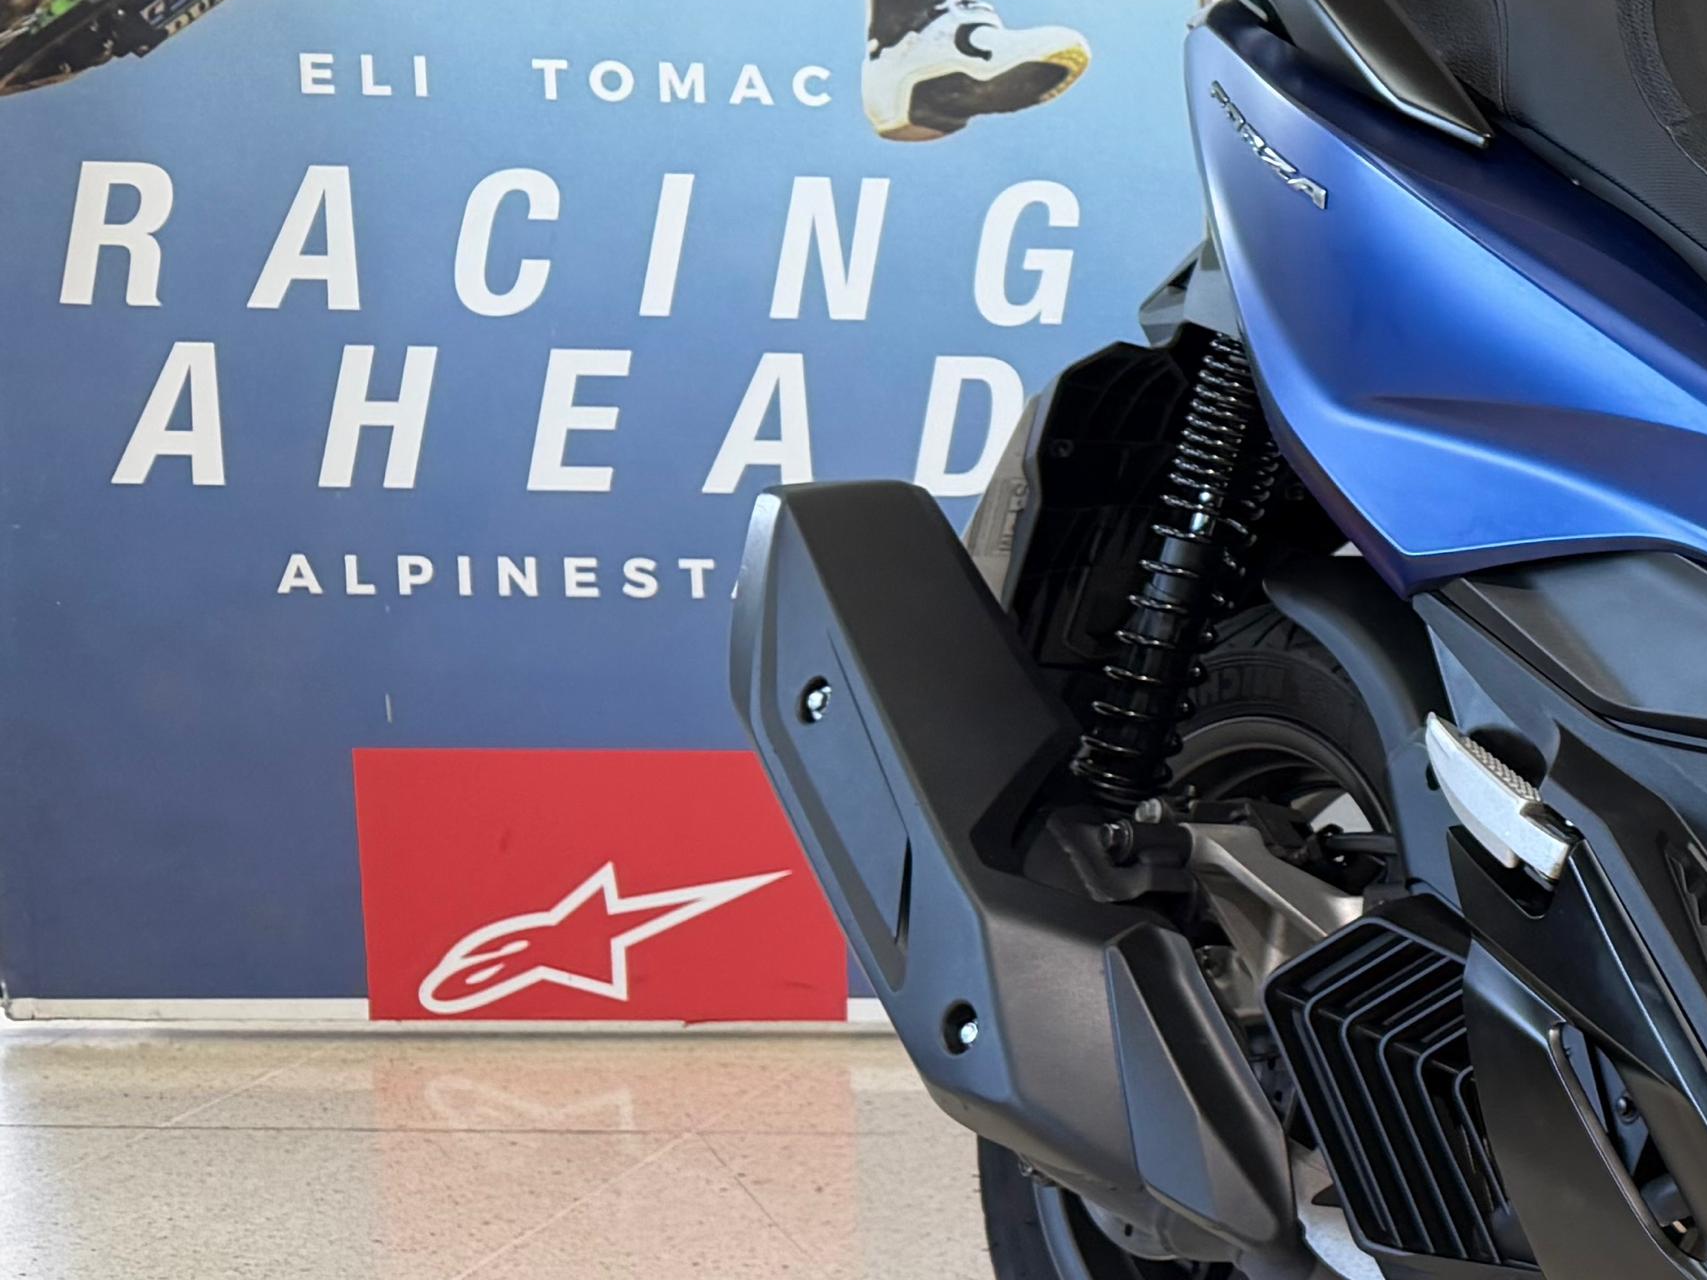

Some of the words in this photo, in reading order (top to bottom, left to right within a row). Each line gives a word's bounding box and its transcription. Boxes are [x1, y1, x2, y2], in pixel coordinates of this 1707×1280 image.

[298, 52, 430, 98] ELI
[530, 57, 833, 107] TOMAC
[58, 160, 1081, 326] RACING
[111, 341, 1025, 499] AHEAD
[277, 554, 742, 598] ALPINEST
